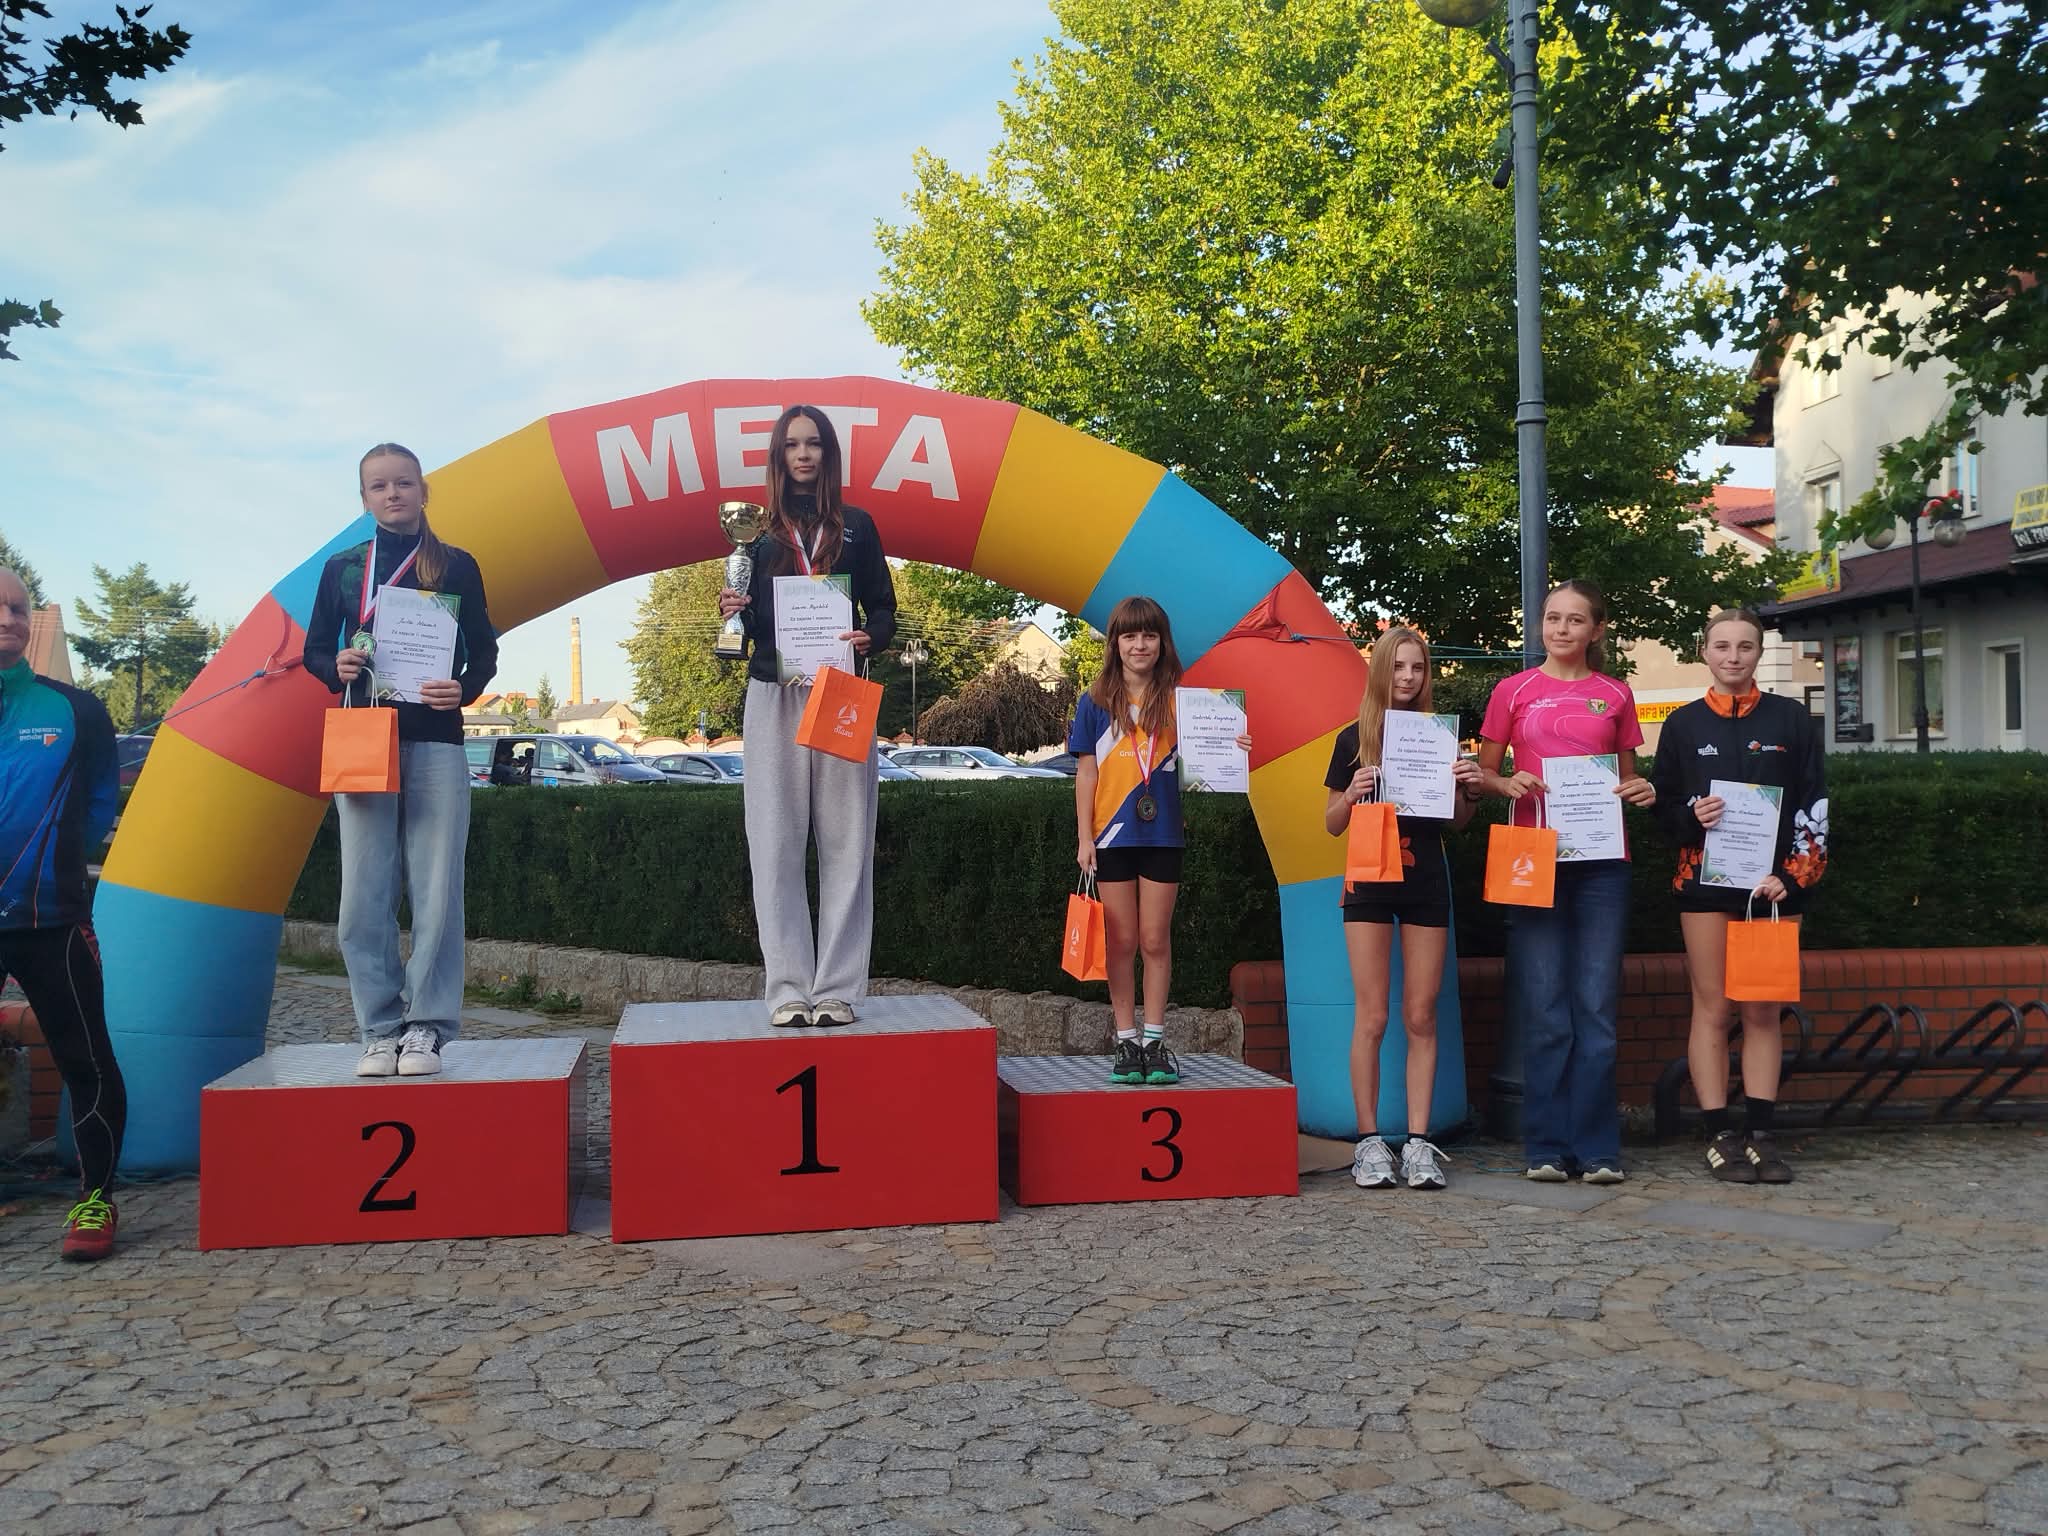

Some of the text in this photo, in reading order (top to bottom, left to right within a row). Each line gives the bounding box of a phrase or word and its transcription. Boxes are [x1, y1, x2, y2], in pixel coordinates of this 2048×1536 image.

[360, 1120, 417, 1212] 2
[776, 1066, 840, 1175] 1
[1141, 1106, 1183, 1182] 3
